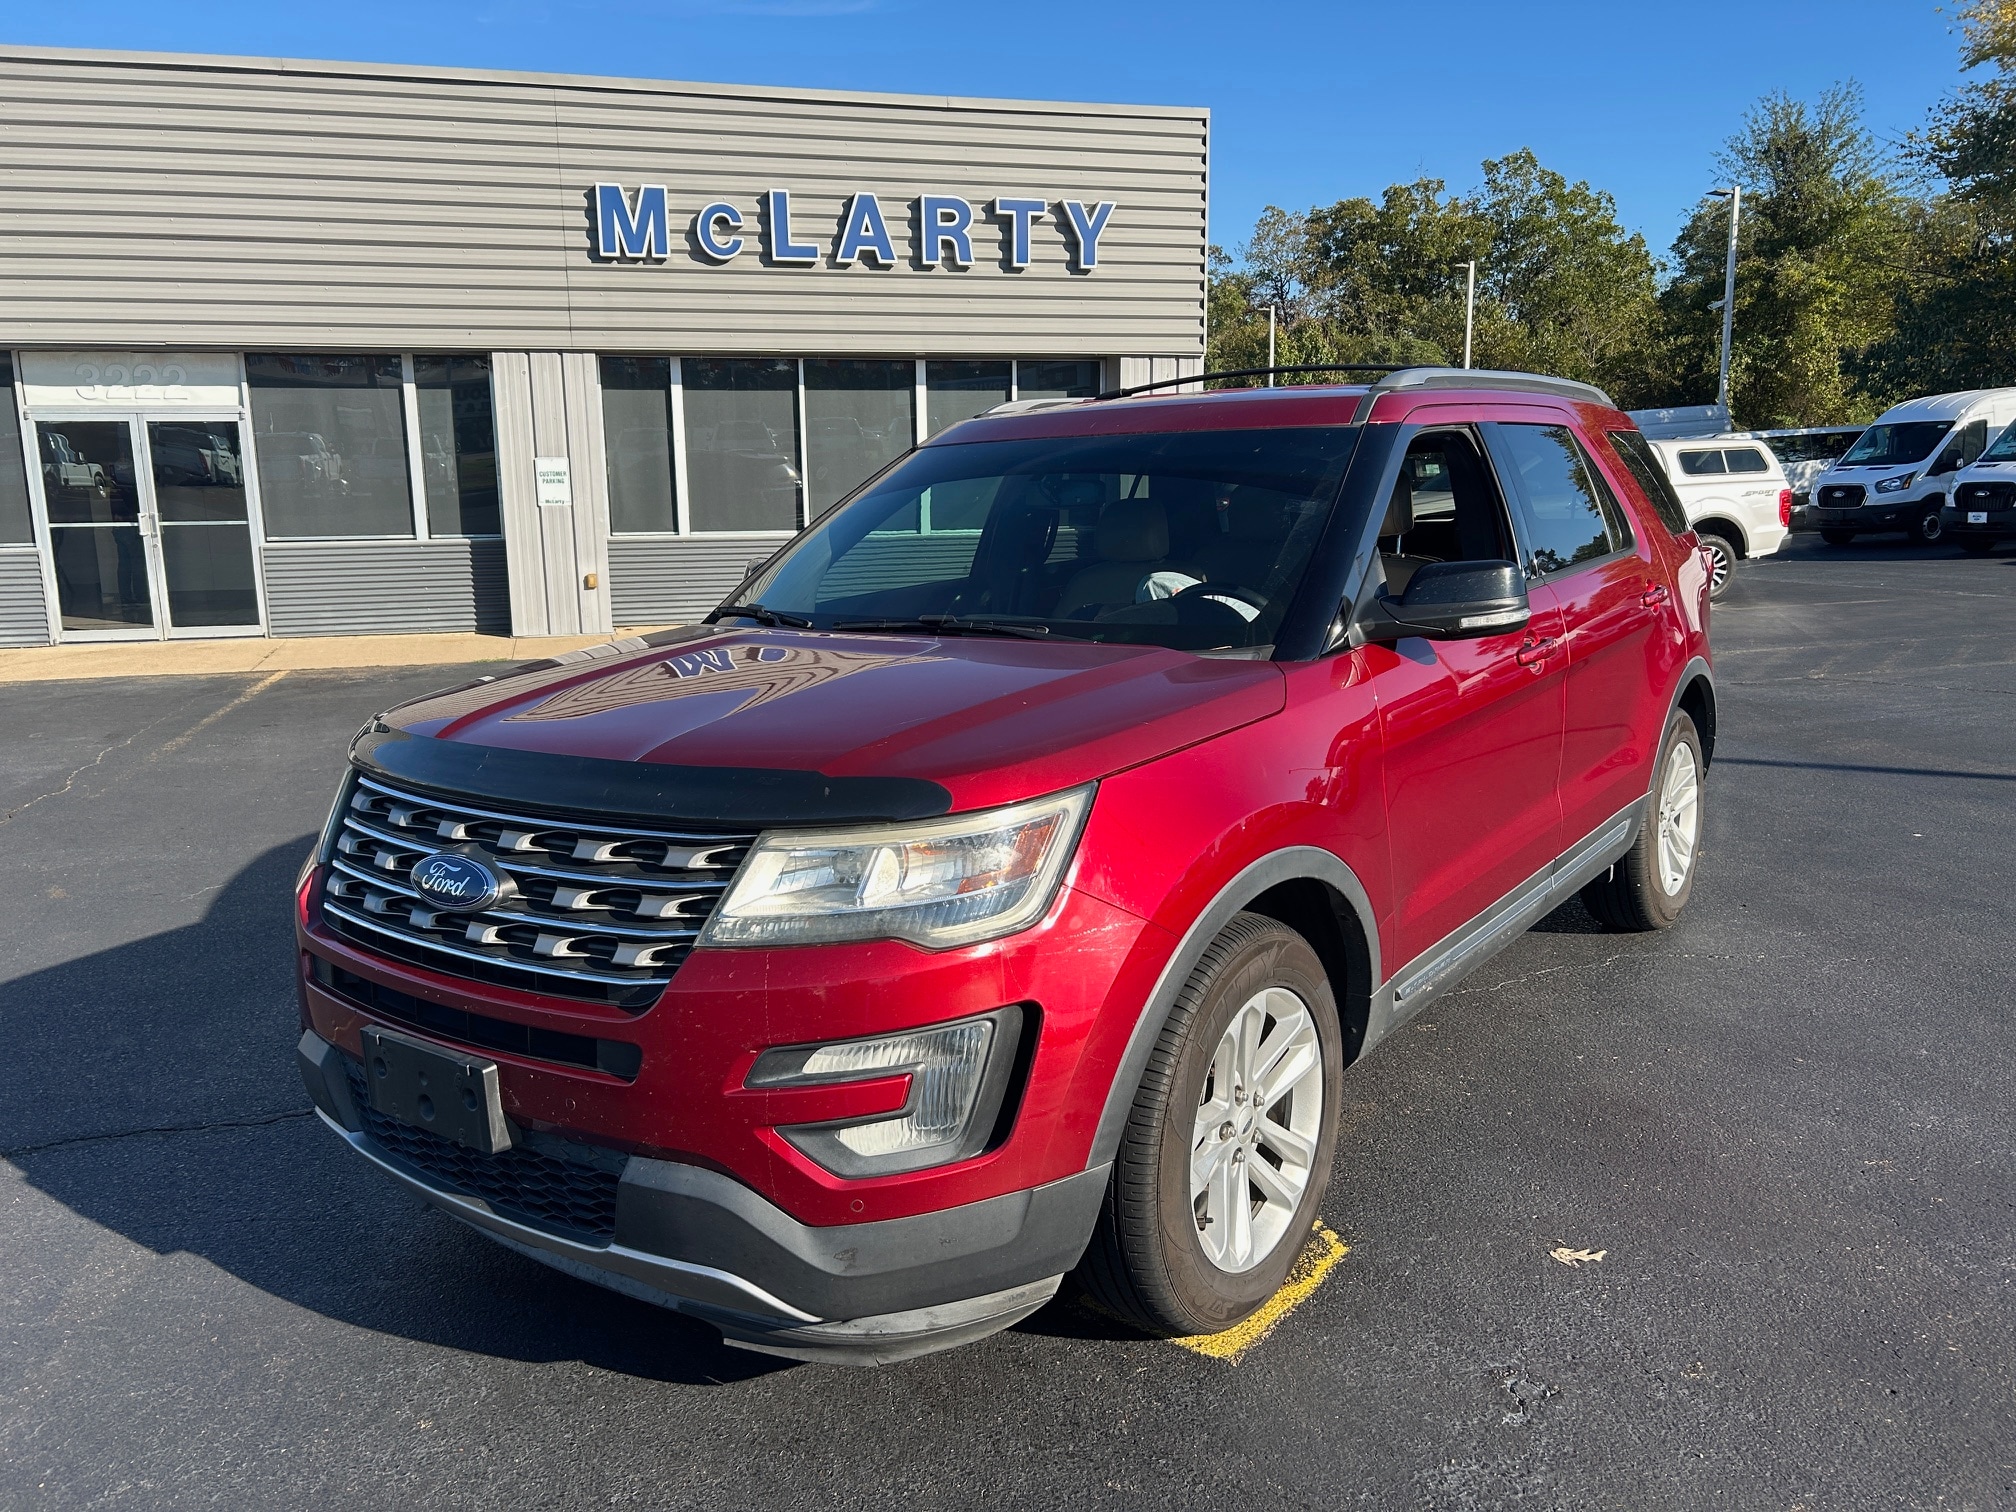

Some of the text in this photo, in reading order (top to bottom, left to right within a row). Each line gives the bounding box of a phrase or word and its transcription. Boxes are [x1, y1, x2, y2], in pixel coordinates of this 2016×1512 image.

[75, 364, 188, 400] 3222
[1741, 489, 1778, 497] SPORT
[421, 861, 470, 897] Ford
